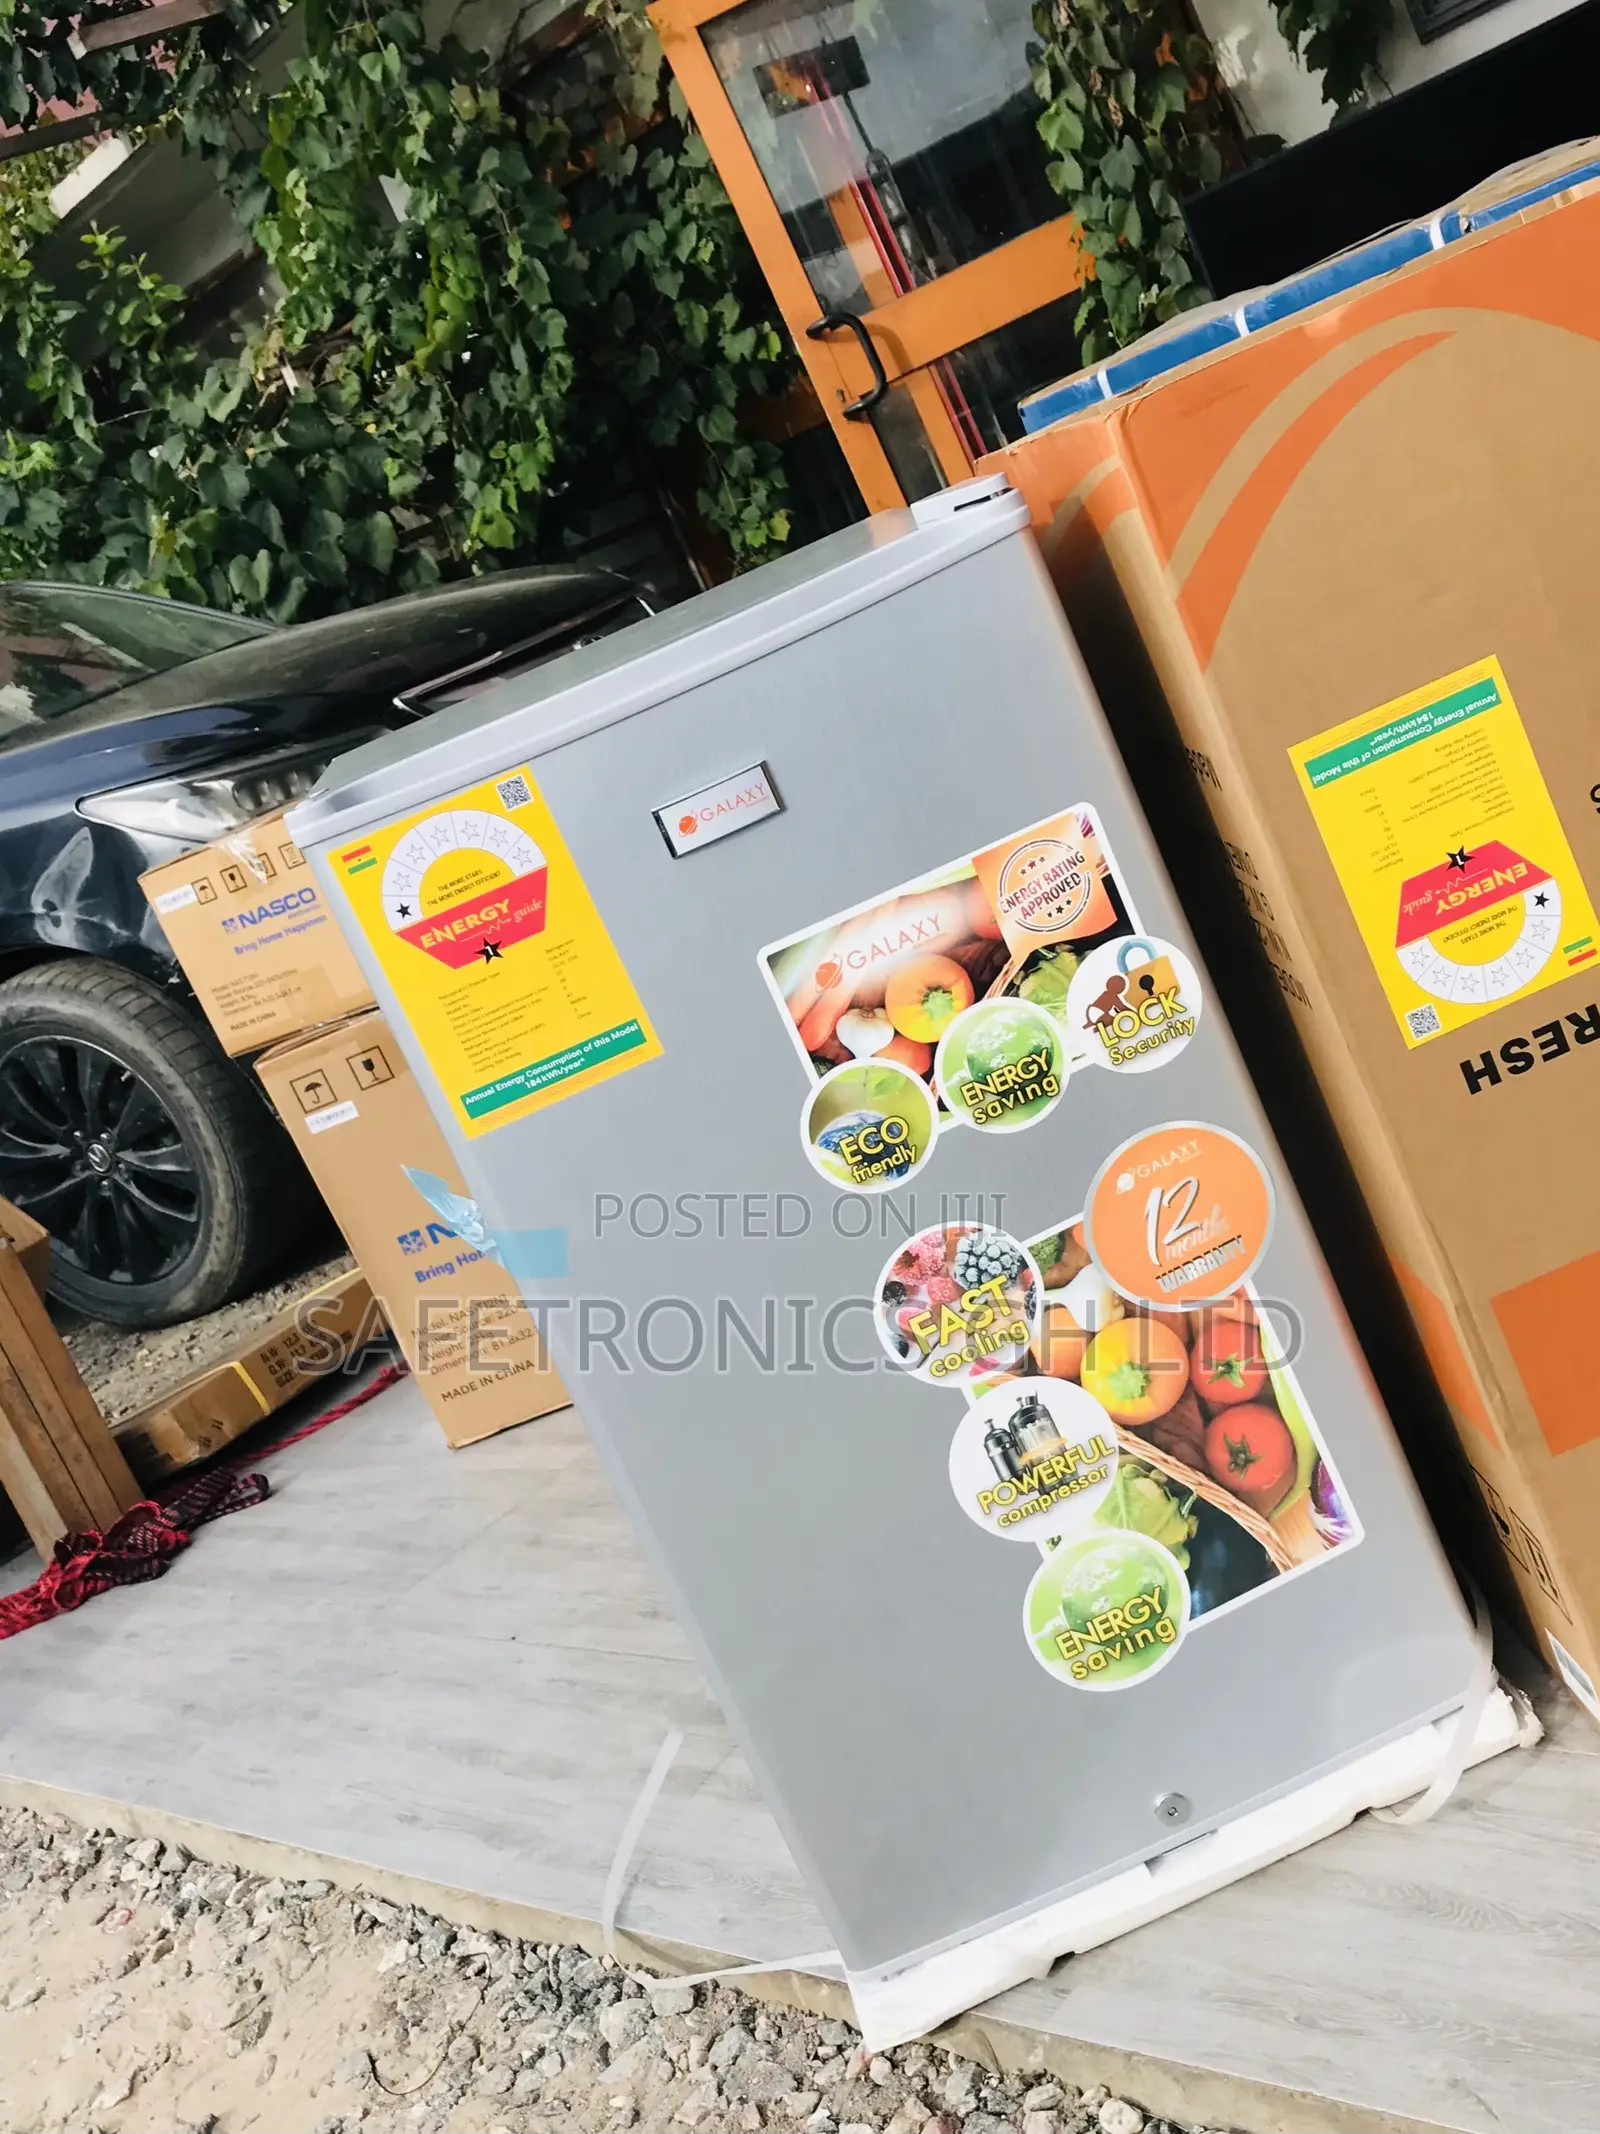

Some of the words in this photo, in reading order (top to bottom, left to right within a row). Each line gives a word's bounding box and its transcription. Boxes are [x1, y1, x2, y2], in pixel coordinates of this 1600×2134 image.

[1417, 712, 1434, 726] 184
[1434, 705, 1465, 727] Energy
[1465, 693, 1497, 714] Annual
[1361, 750, 1371, 764] of
[1372, 724, 1433, 755] Consumption
[1312, 761, 1342, 785] Model
[1342, 756, 1361, 770] this
[700, 782, 765, 821] GALAXY
[437, 882, 450, 892] THE
[449, 876, 465, 888] MORE
[465, 869, 483, 882] STARS
[1455, 855, 1465, 866] 1
[427, 896, 438, 906] THE
[438, 890, 454, 903] MORE
[1000, 881, 1044, 915] ENERGY
[1044, 851, 1086, 885] RATING
[1020, 872, 1082, 921] APPROVED
[1403, 890, 1433, 916] guide
[1435, 862, 1529, 916] ENERGY
[238, 887, 317, 928] NASCO
[420, 898, 511, 949] ENERGY
[513, 898, 543, 922] guide
[1490, 910, 1507, 921] MORE
[1496, 920, 1506, 929] THE
[1507, 905, 1518, 914] THE
[486, 945, 494, 956] 1
[846, 913, 944, 970] GALAXY
[1460, 932, 1479, 945] STARS
[1480, 925, 1495, 935] MORE
[1096, 987, 1187, 1050] LOCK
[1109, 1014, 1196, 1066] Security
[465, 1086, 496, 1106] Annual
[495, 1075, 526, 1094] Energy
[526, 1049, 583, 1079] Consumption
[583, 1042, 594, 1053] of
[593, 1033, 611, 1048] this
[611, 1022, 639, 1041] Model
[960, 1048, 1051, 1108] ENERGY
[973, 1071, 1061, 1125] saving
[839, 1115, 910, 1167] ECO
[1136, 1138, 1199, 1178] GALAXY
[850, 1143, 918, 1185] friendly
[1144, 1175, 1203, 1268] 12
[414, 1261, 456, 1284] Bring
[1155, 1234, 1247, 1294] WARRANTY
[908, 1274, 1015, 1356] FAST
[929, 1319, 1031, 1379] cooling
[440, 1381, 479, 1402] MADE
[479, 1375, 495, 1388] IN
[494, 1359, 536, 1382] CHINA
[976, 1434, 1116, 1515] POWERFUL
[997, 1463, 1110, 1528] compressor
[1054, 1585, 1163, 1661] ENERGY
[1070, 1616, 1177, 1680] saving
